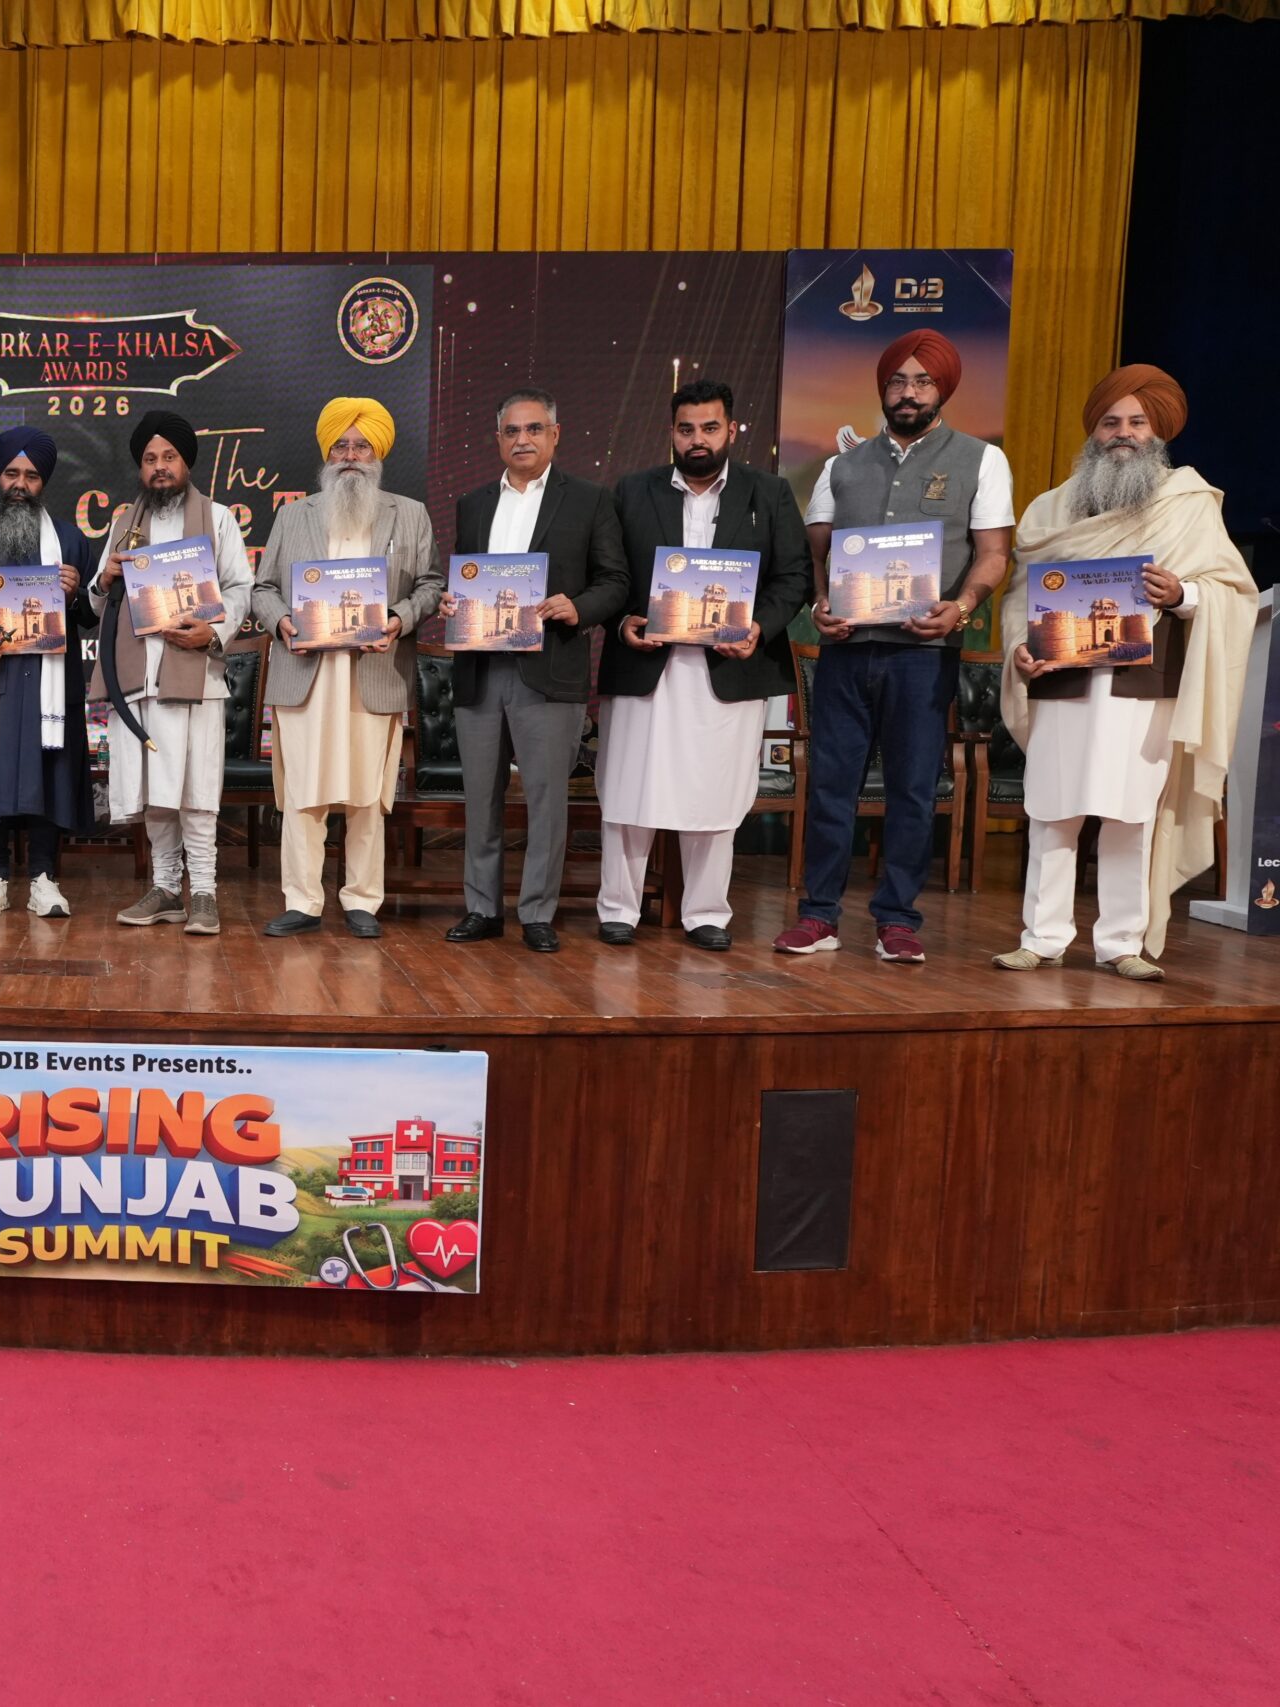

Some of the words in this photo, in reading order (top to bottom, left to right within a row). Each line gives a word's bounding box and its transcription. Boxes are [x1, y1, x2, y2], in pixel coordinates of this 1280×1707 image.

[40, 361, 128, 381] AWARDS
[47, 396, 130, 416] 2026
[195, 427, 279, 500] The
[1071, 570, 1140, 581] SARKAR-E-KHALS
[1082, 578, 1110, 586] AWARD
[1112, 576, 1133, 584] 2026
[47, 1052, 126, 1073] Events
[132, 1054, 253, 1075] Presents..
